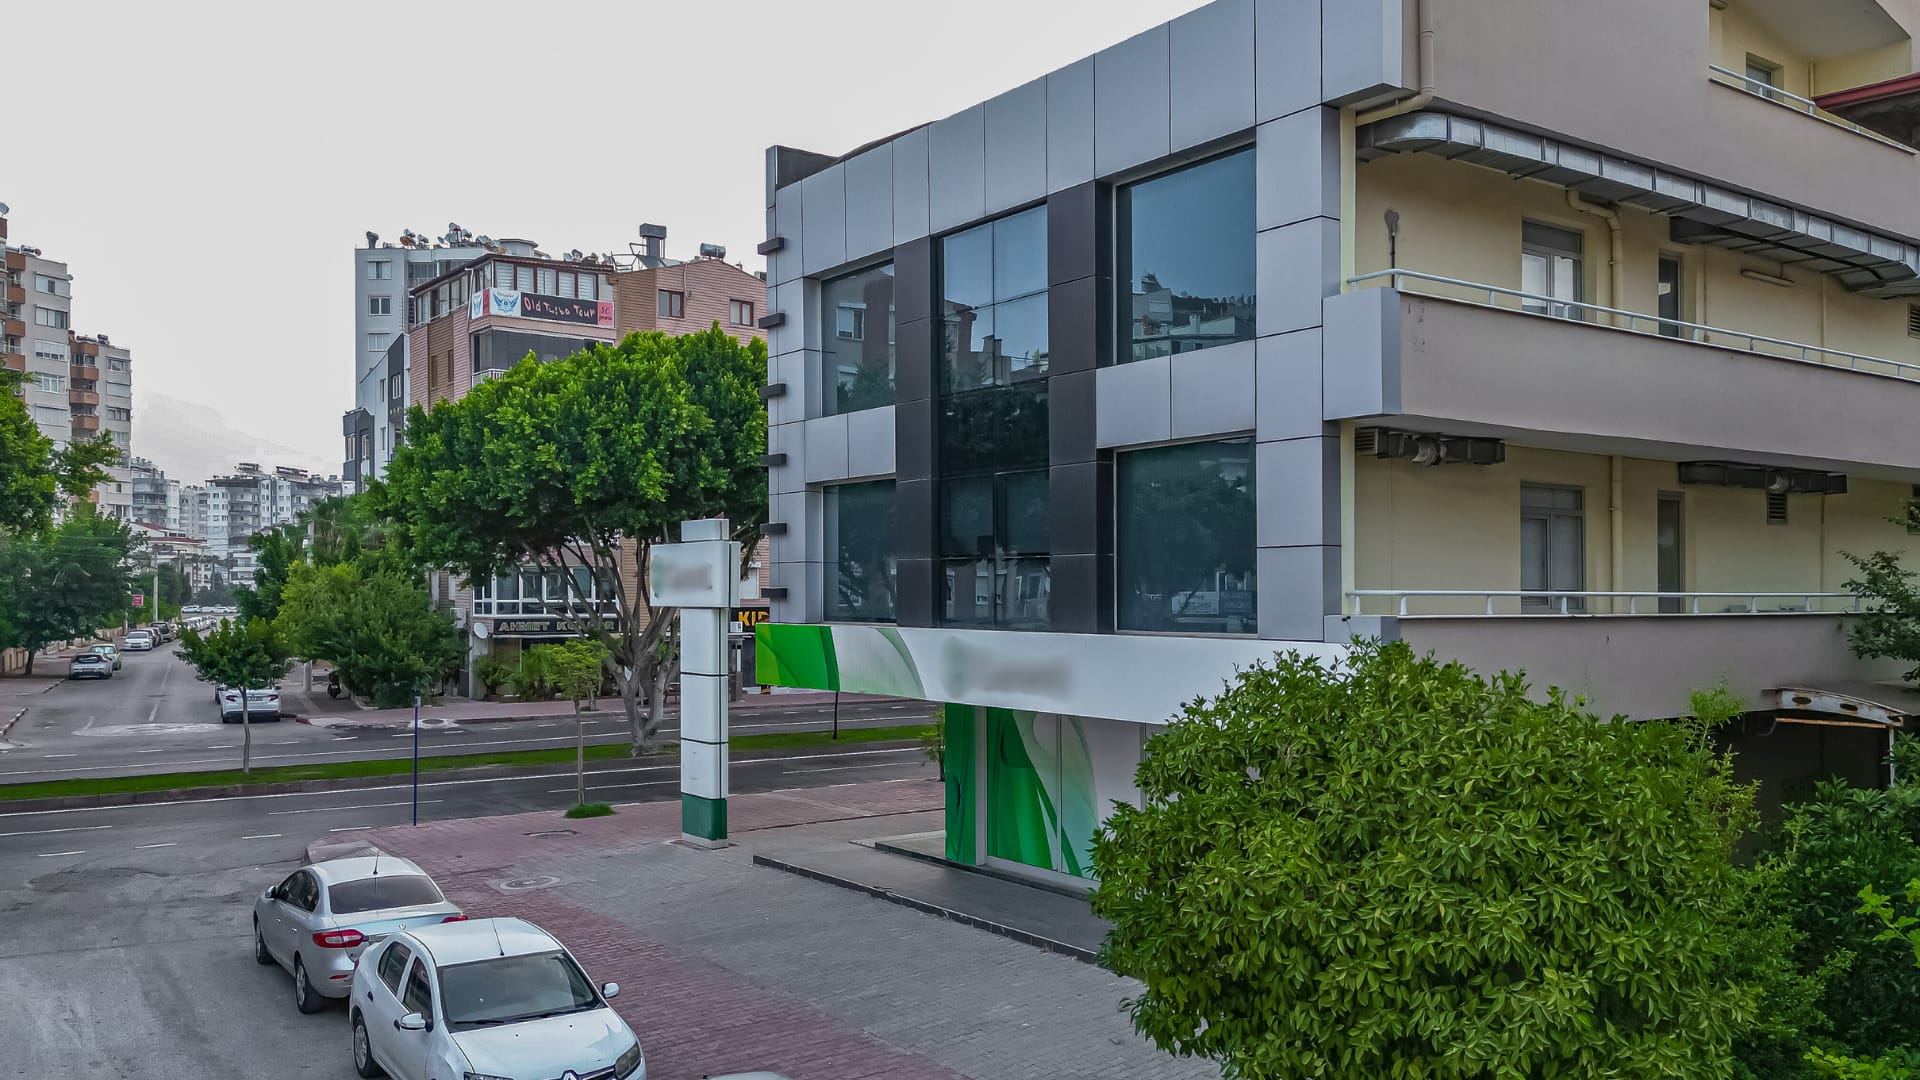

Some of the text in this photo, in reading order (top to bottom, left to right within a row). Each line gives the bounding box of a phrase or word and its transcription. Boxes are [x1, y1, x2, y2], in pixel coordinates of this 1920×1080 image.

[523, 296, 542, 312] Old
[573, 303, 596, 319] Tour
[498, 621, 550, 632] AHMET
